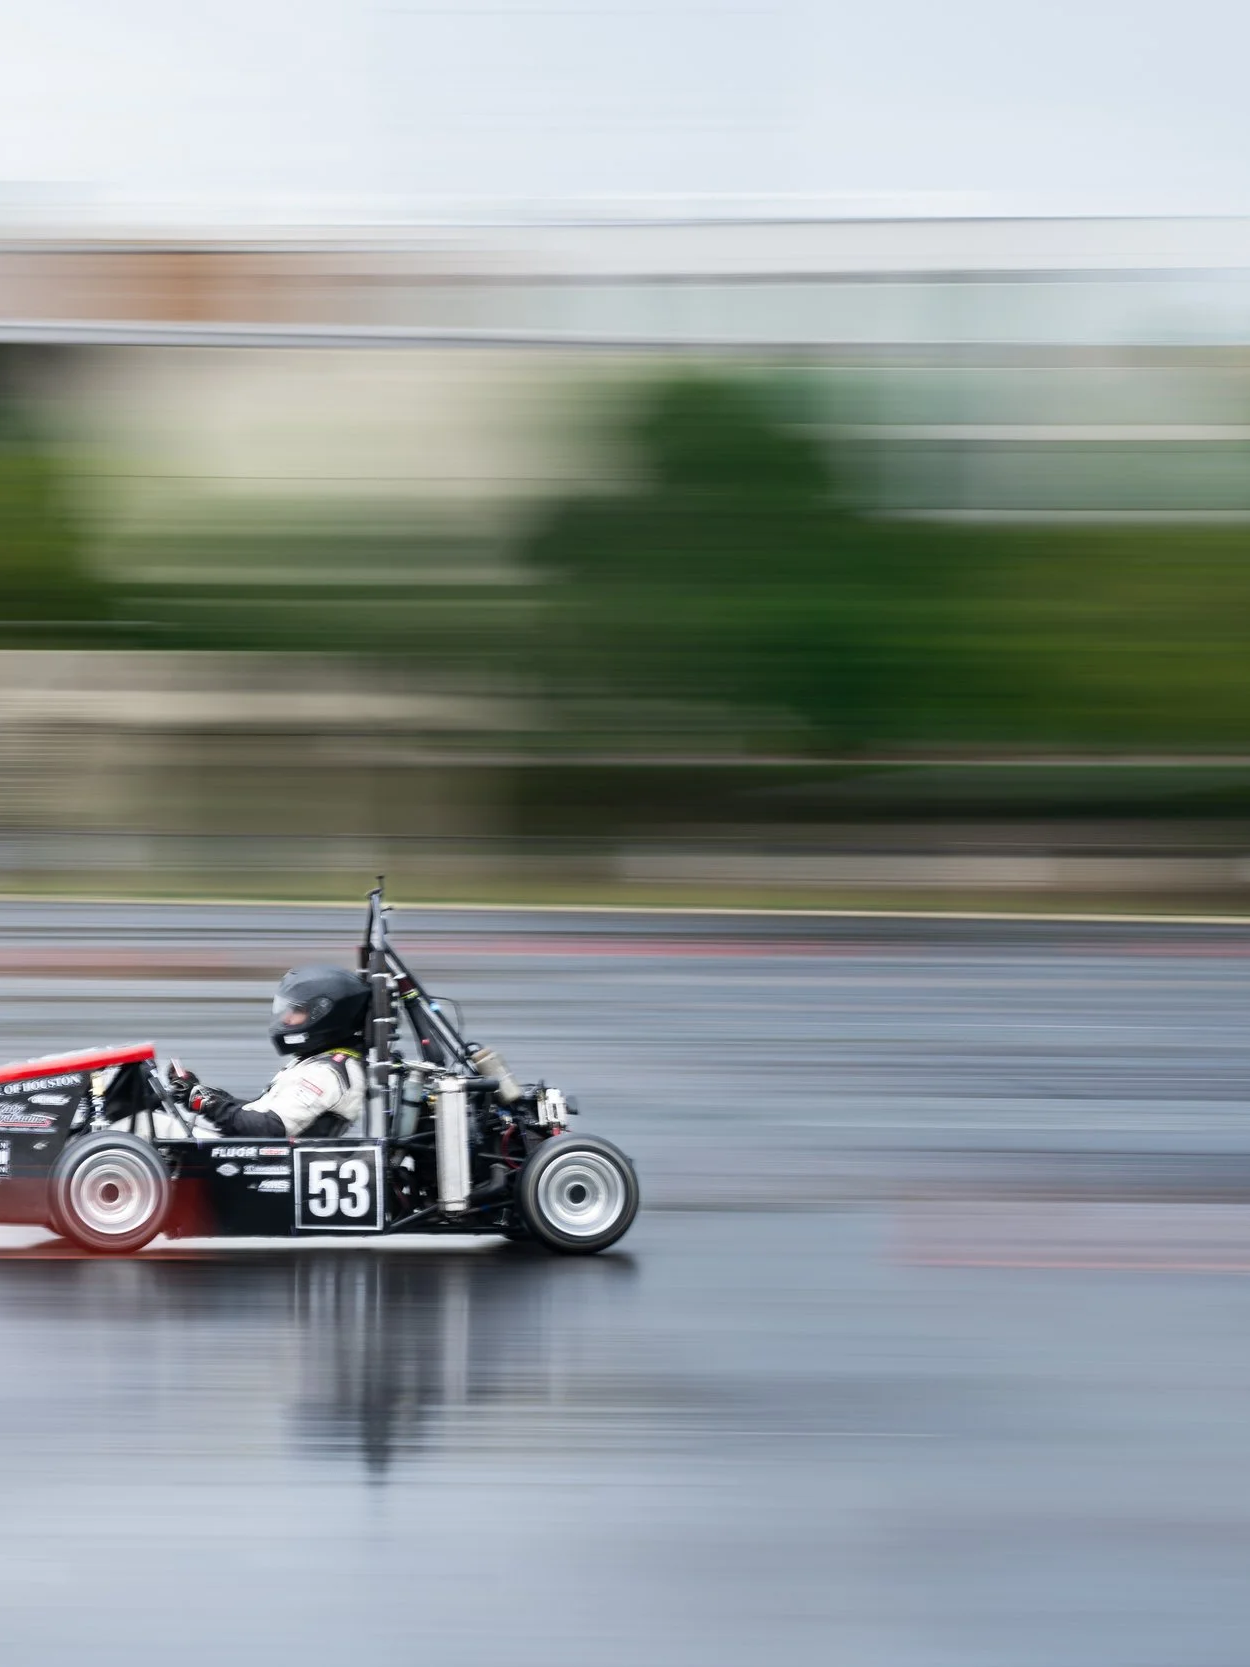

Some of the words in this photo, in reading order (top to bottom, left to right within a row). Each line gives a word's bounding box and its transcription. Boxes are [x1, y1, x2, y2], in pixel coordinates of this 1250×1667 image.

[4, 1083, 22, 1094] OF
[22, 1075, 81, 1091] HOUSTON
[308, 1159, 370, 1217] 53
